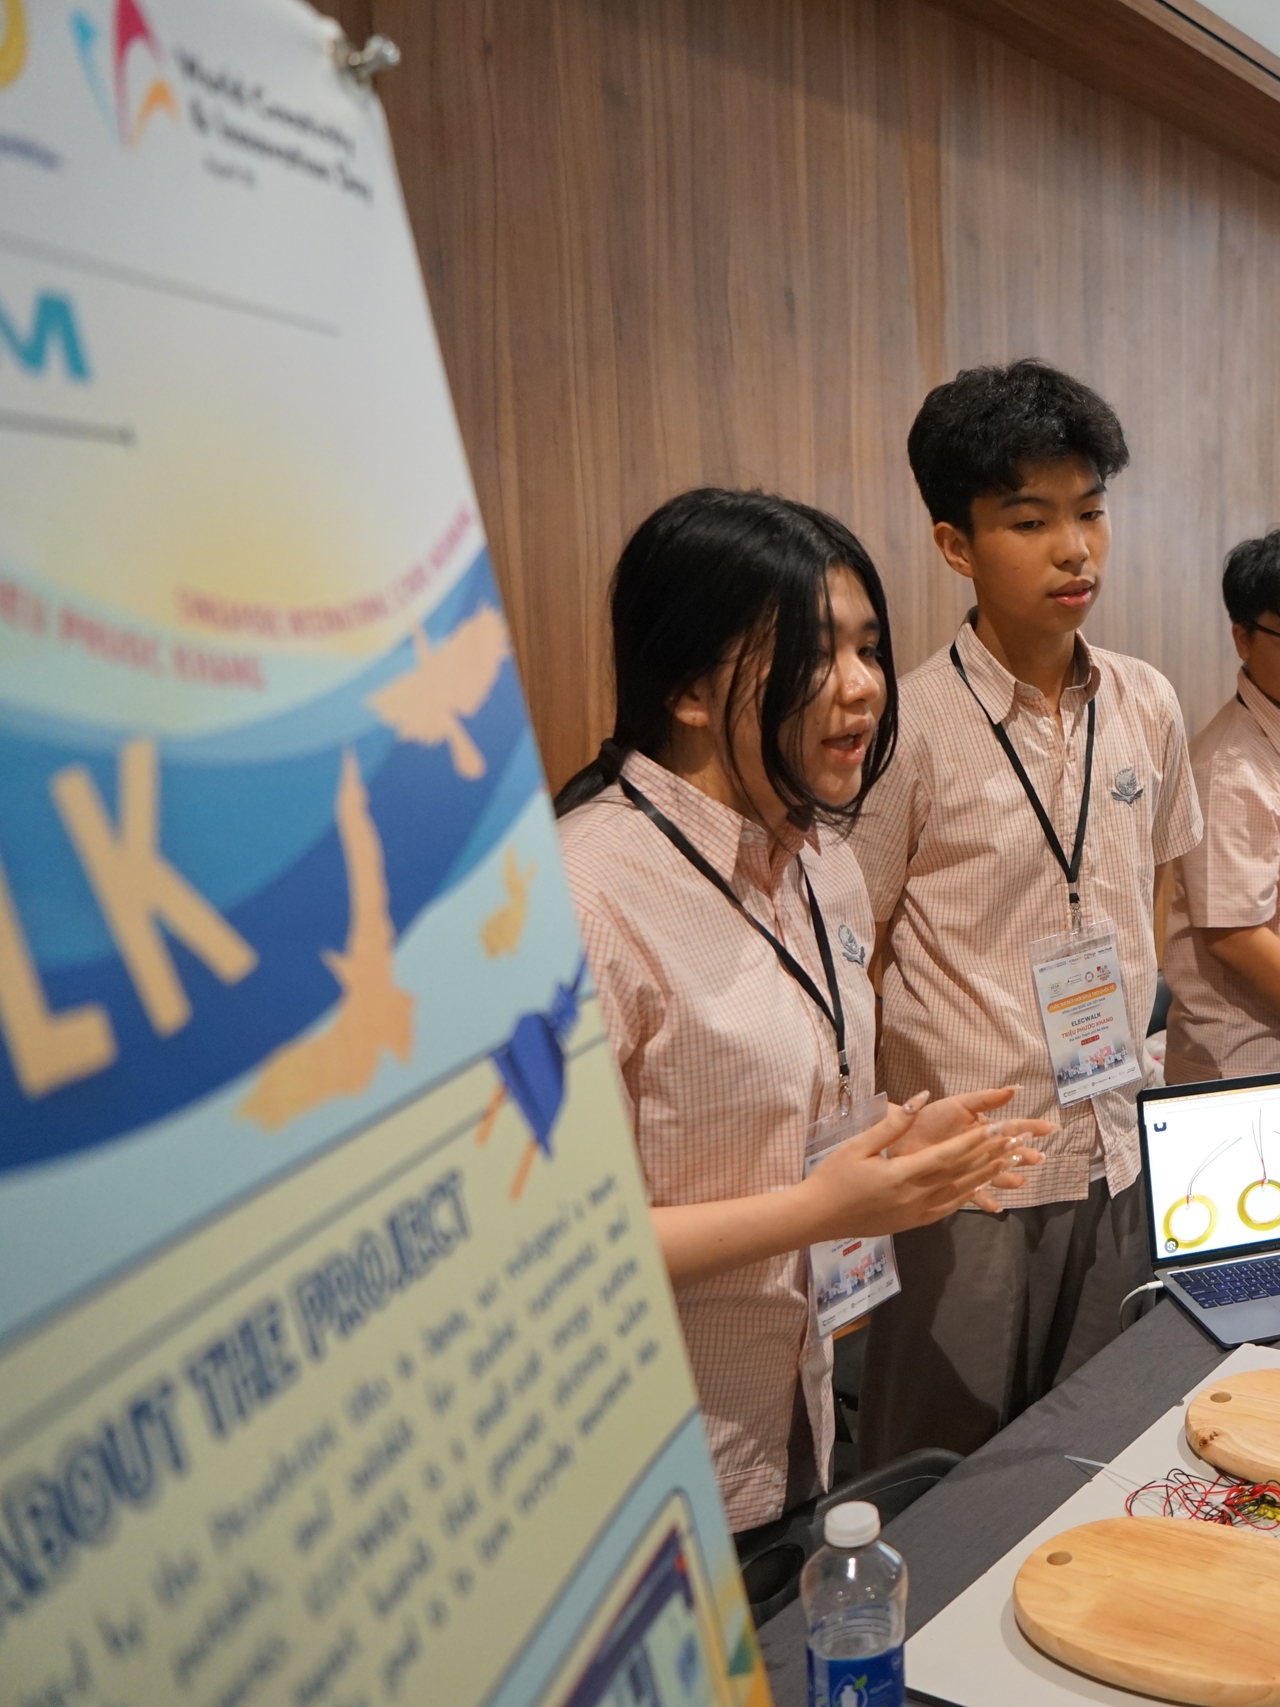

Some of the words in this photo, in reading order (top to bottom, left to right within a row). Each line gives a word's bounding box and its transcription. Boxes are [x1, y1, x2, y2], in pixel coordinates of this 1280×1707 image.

[1071, 1012, 1102, 1027] ELECWALK
[1095, 1016, 1114, 1026] KHANG
[182, 1296, 303, 1441] THE
[287, 1167, 473, 1365] PROJECT
